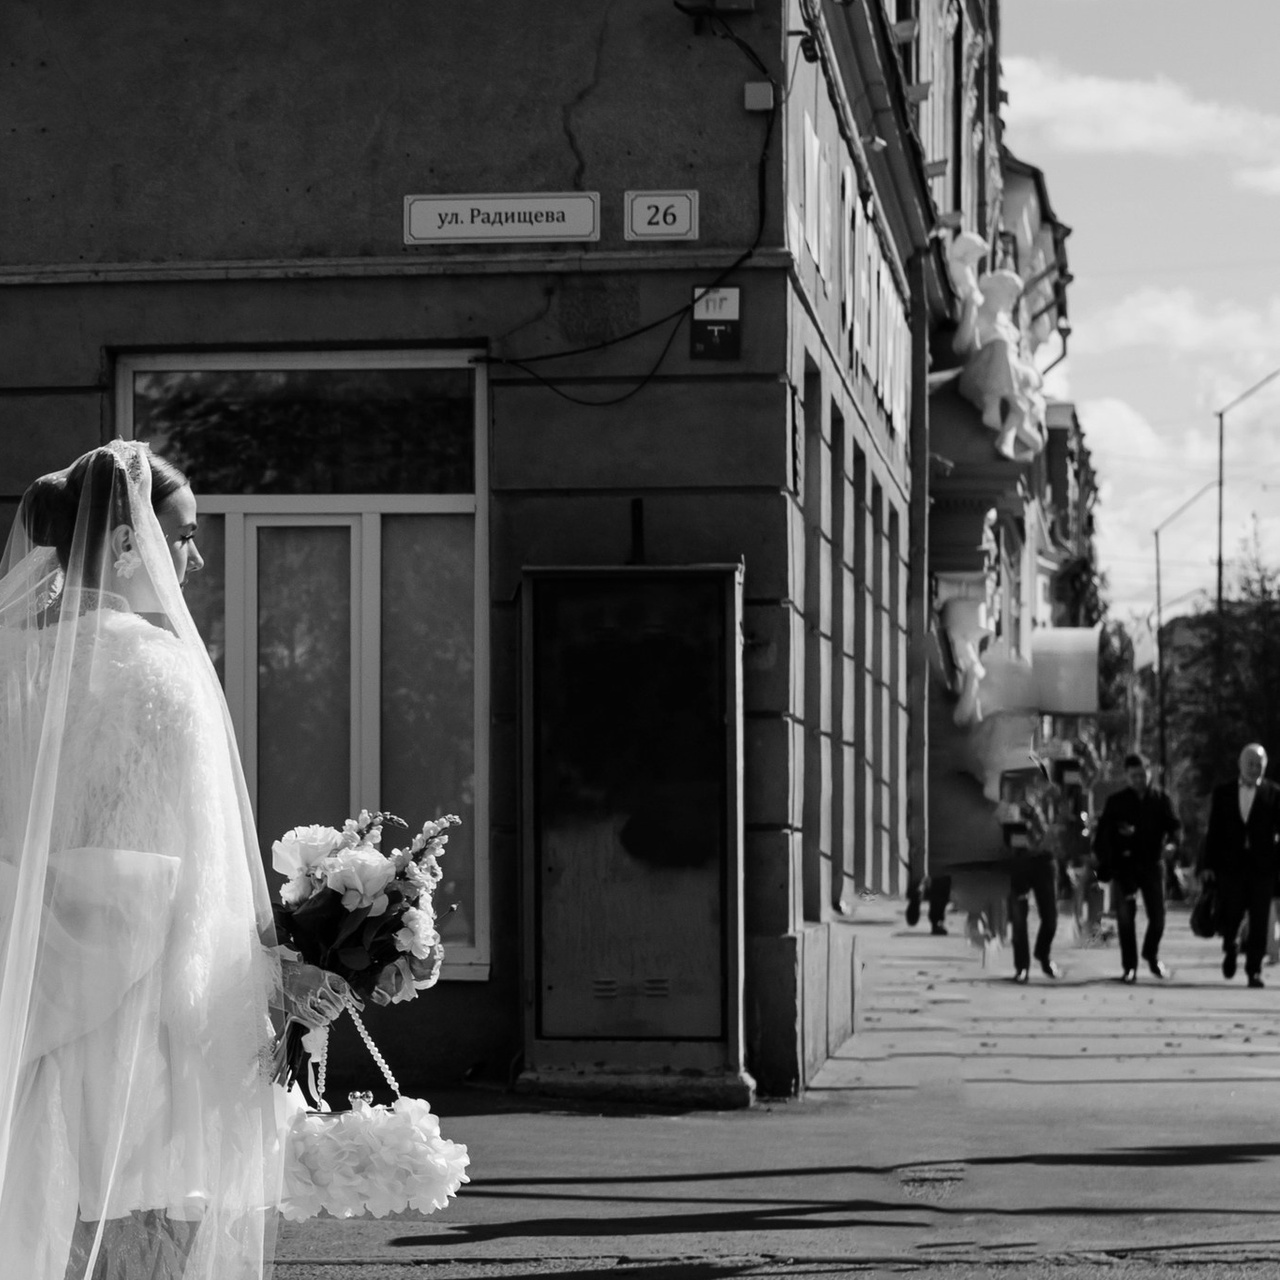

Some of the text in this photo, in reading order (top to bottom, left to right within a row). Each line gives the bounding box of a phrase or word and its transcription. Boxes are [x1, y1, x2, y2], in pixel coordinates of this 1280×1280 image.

[437, 207, 566, 229] ул. Радищева
[646, 204, 677, 227] 26
